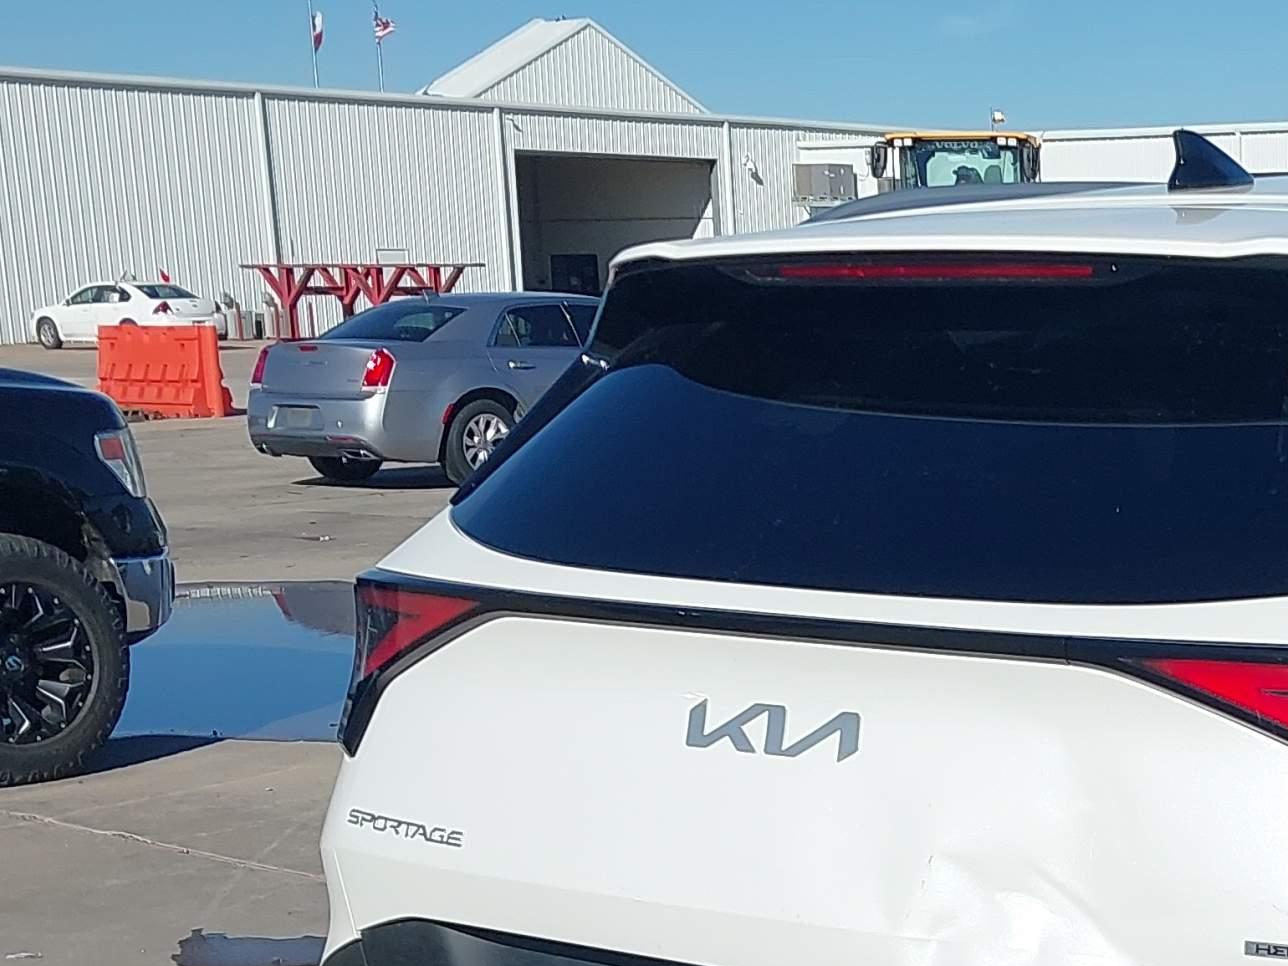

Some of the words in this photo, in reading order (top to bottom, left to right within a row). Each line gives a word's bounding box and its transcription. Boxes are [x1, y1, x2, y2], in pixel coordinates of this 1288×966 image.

[935, 141, 978, 149] VOLVO
[686, 698, 861, 762] KIA
[347, 808, 463, 848] SPORTAGE
